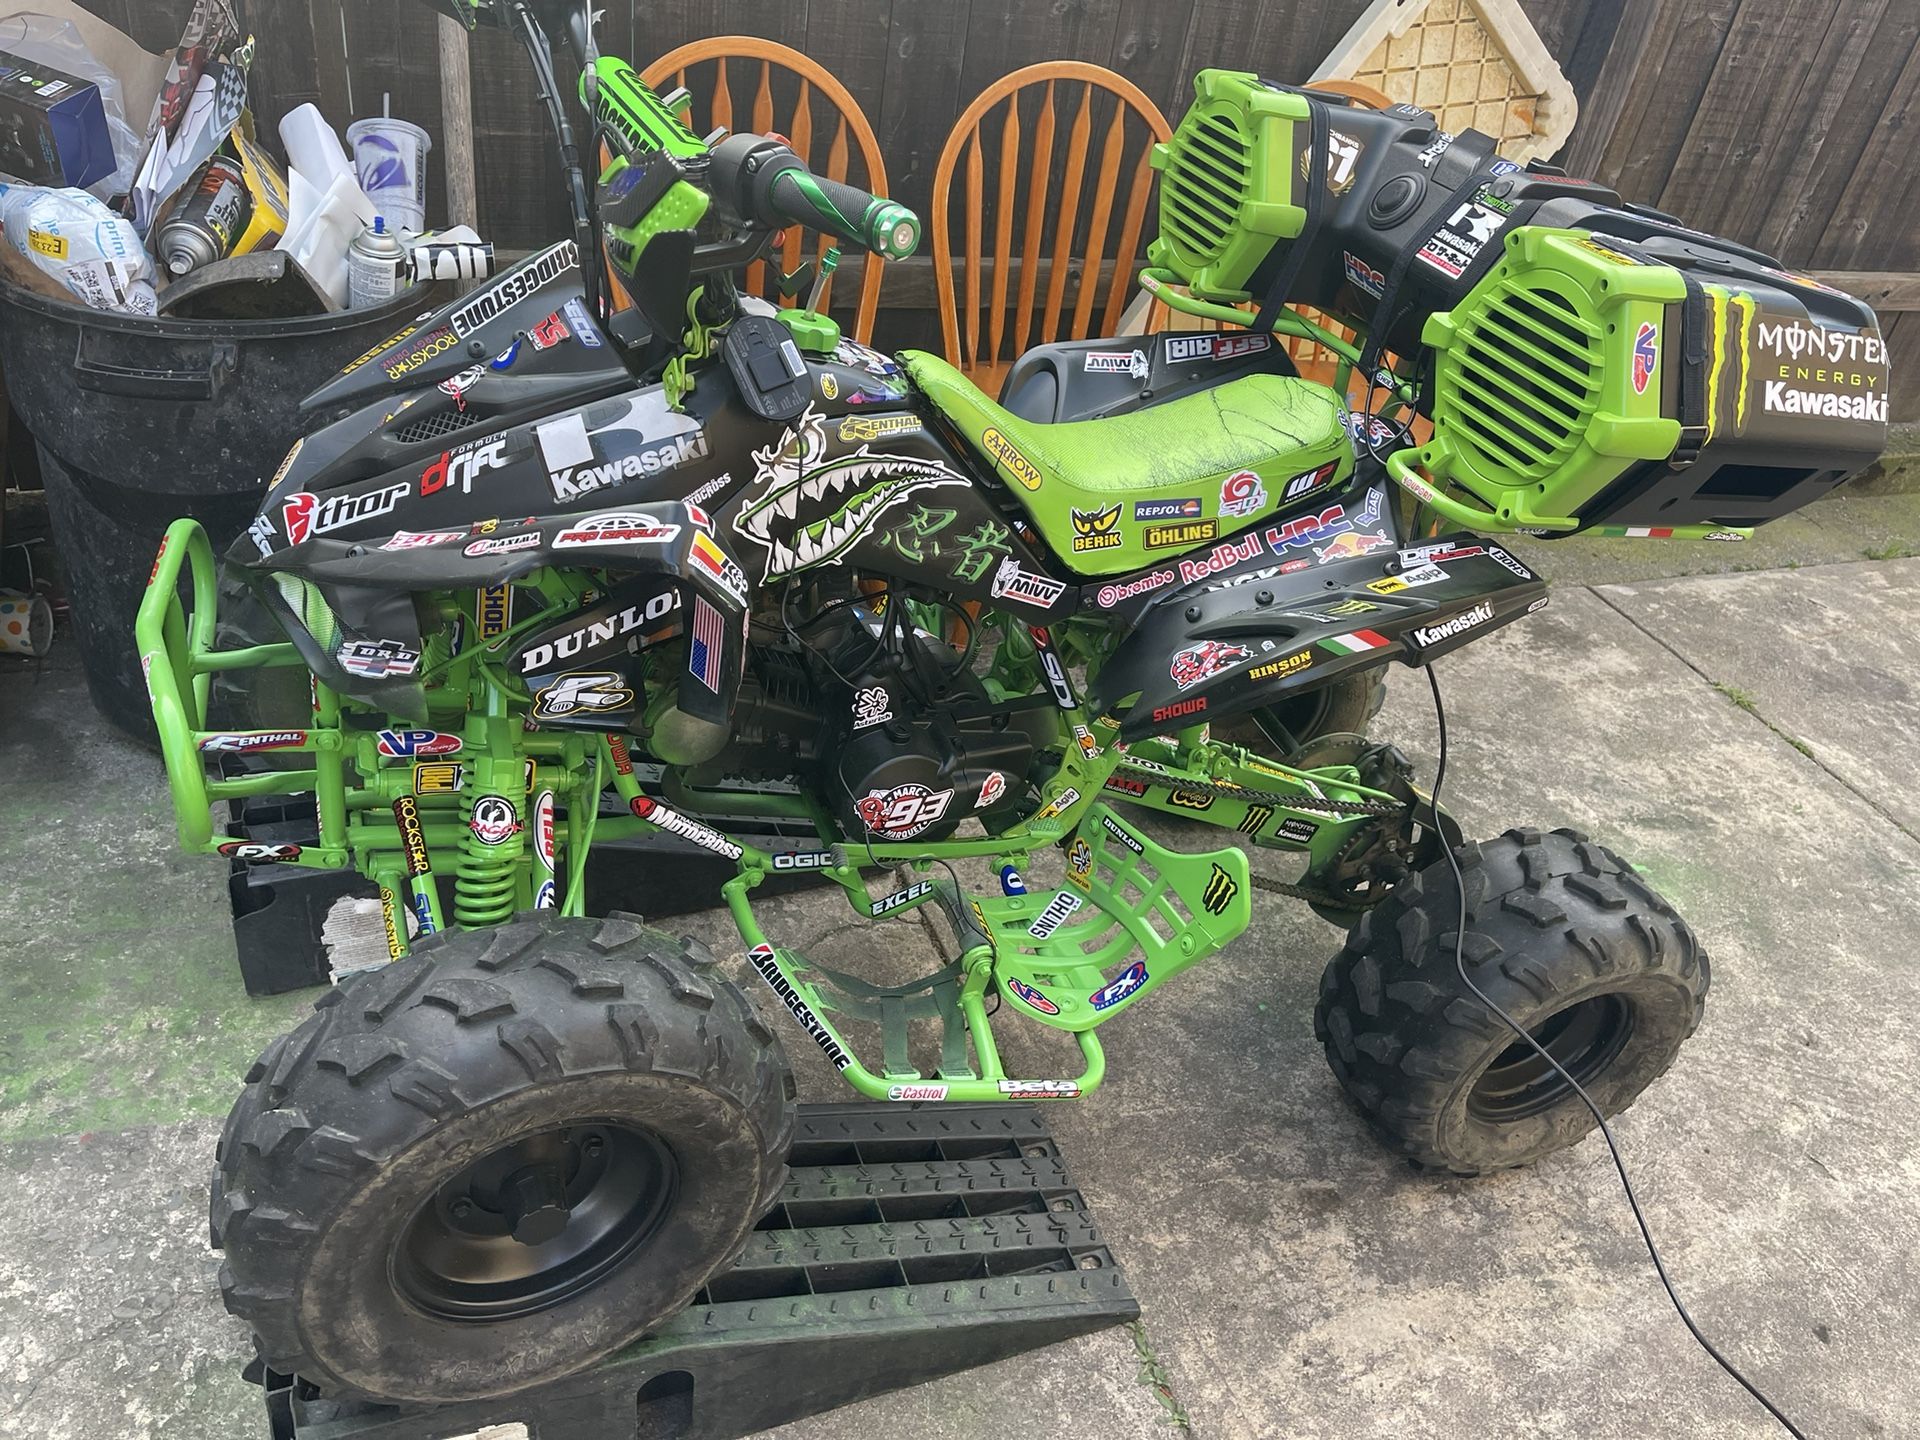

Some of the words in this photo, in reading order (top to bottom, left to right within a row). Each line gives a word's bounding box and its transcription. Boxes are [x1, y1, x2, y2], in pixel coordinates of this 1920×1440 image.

[1171, 337, 1213, 359] AIR
[1217, 335, 1268, 358] SFF
[1779, 365, 1878, 388] ENERGY
[1764, 380, 1888, 422] Kawasaki
[450, 430, 508, 457] FORMULA
[550, 427, 709, 499] Kawasaki
[988, 434, 1039, 482] ARROW
[315, 484, 408, 531] thor
[1136, 505, 1181, 517] REPSOL
[559, 529, 600, 543] PRO
[598, 526, 674, 542] CIRCUIT
[1149, 523, 1215, 547] ÖHLINS
[1266, 504, 1355, 556] HRC
[1404, 567, 1443, 585] Agip
[1491, 549, 1530, 577] SHOEI
[1116, 570, 1175, 601] brembo
[1414, 602, 1495, 648] Kawasaki
[1248, 650, 1313, 680] HINSON
[1152, 697, 1208, 723] SHOWA
[201, 733, 303, 751] RENTHAL
[892, 786, 923, 800] MARC
[883, 791, 952, 830] 93
[646, 805, 743, 861] MOTOCROSS
[883, 823, 925, 839] MARQUEZ
[1102, 818, 1144, 853] DUNLOP
[871, 881, 933, 917] EXCEL
[749, 948, 851, 1072] BRIDGESTONE
[902, 1085, 944, 1100] Castrol
